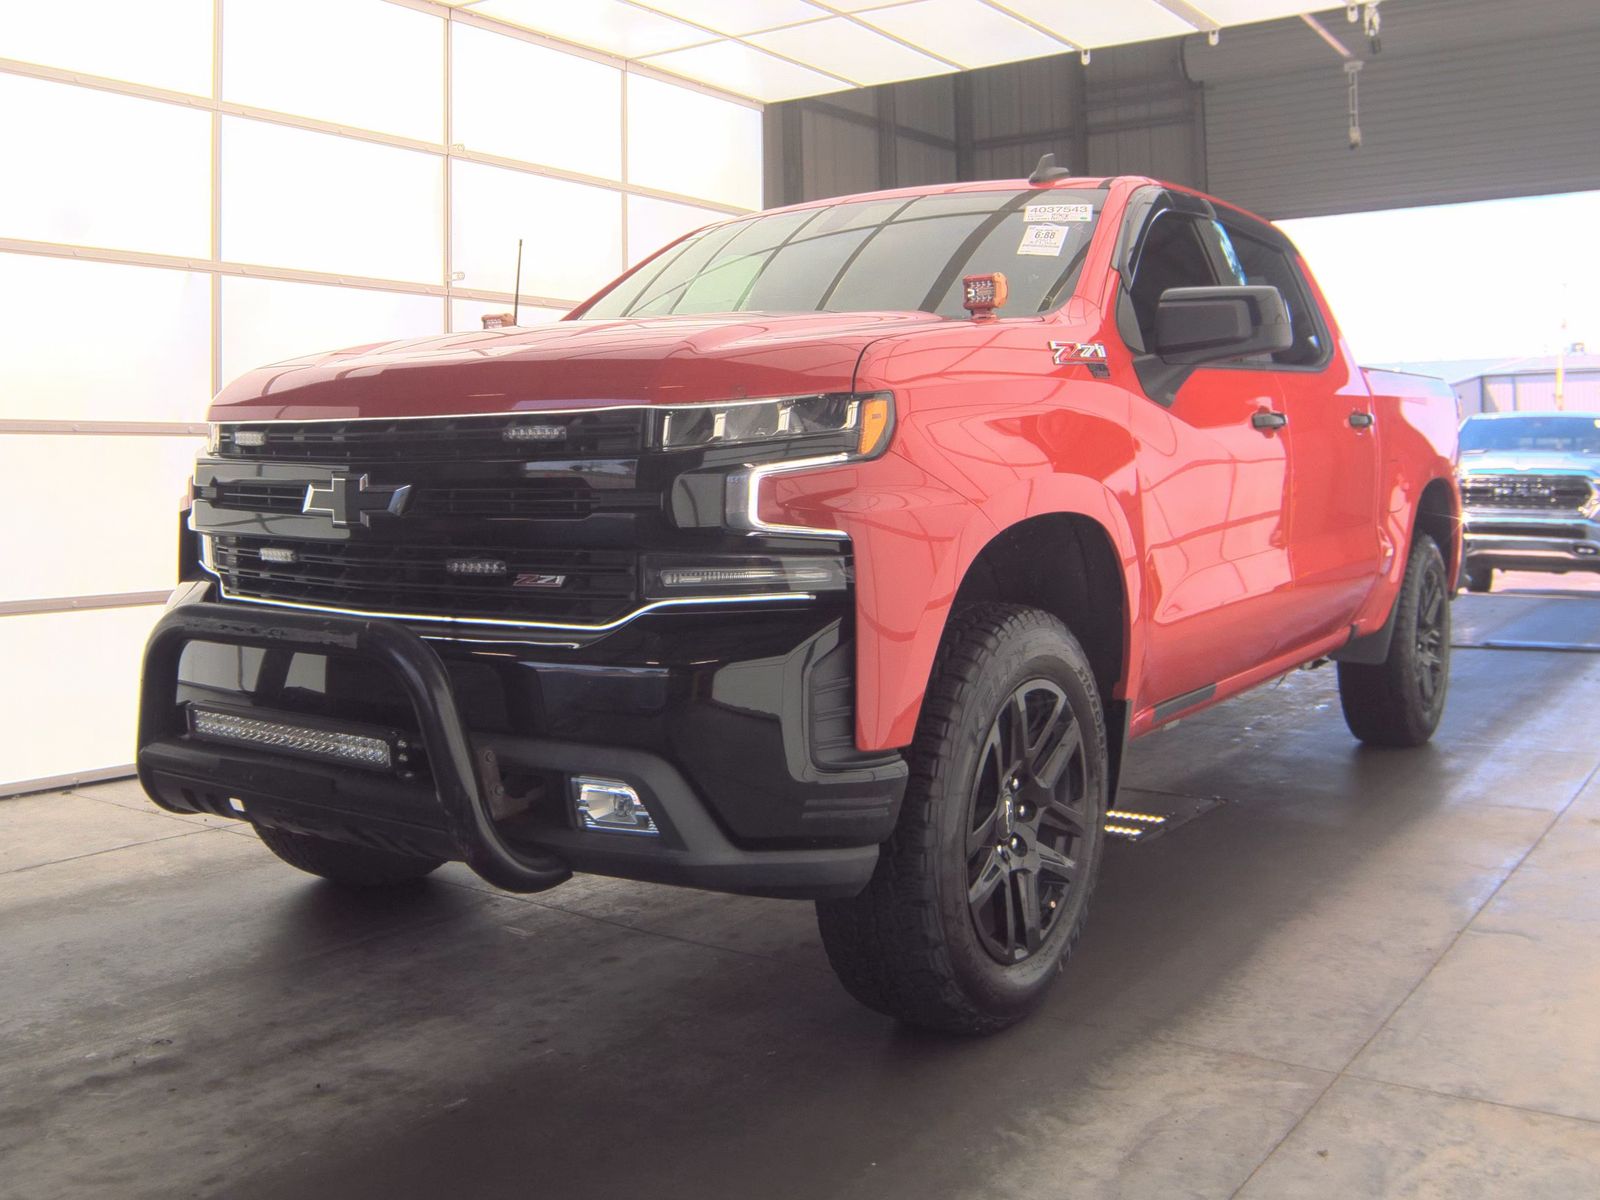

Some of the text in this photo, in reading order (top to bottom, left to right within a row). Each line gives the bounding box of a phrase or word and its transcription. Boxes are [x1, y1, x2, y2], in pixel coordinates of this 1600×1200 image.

[1030, 206, 1088, 214] 4037543
[1048, 340, 1107, 365] Z71
[512, 573, 566, 588] Z71
